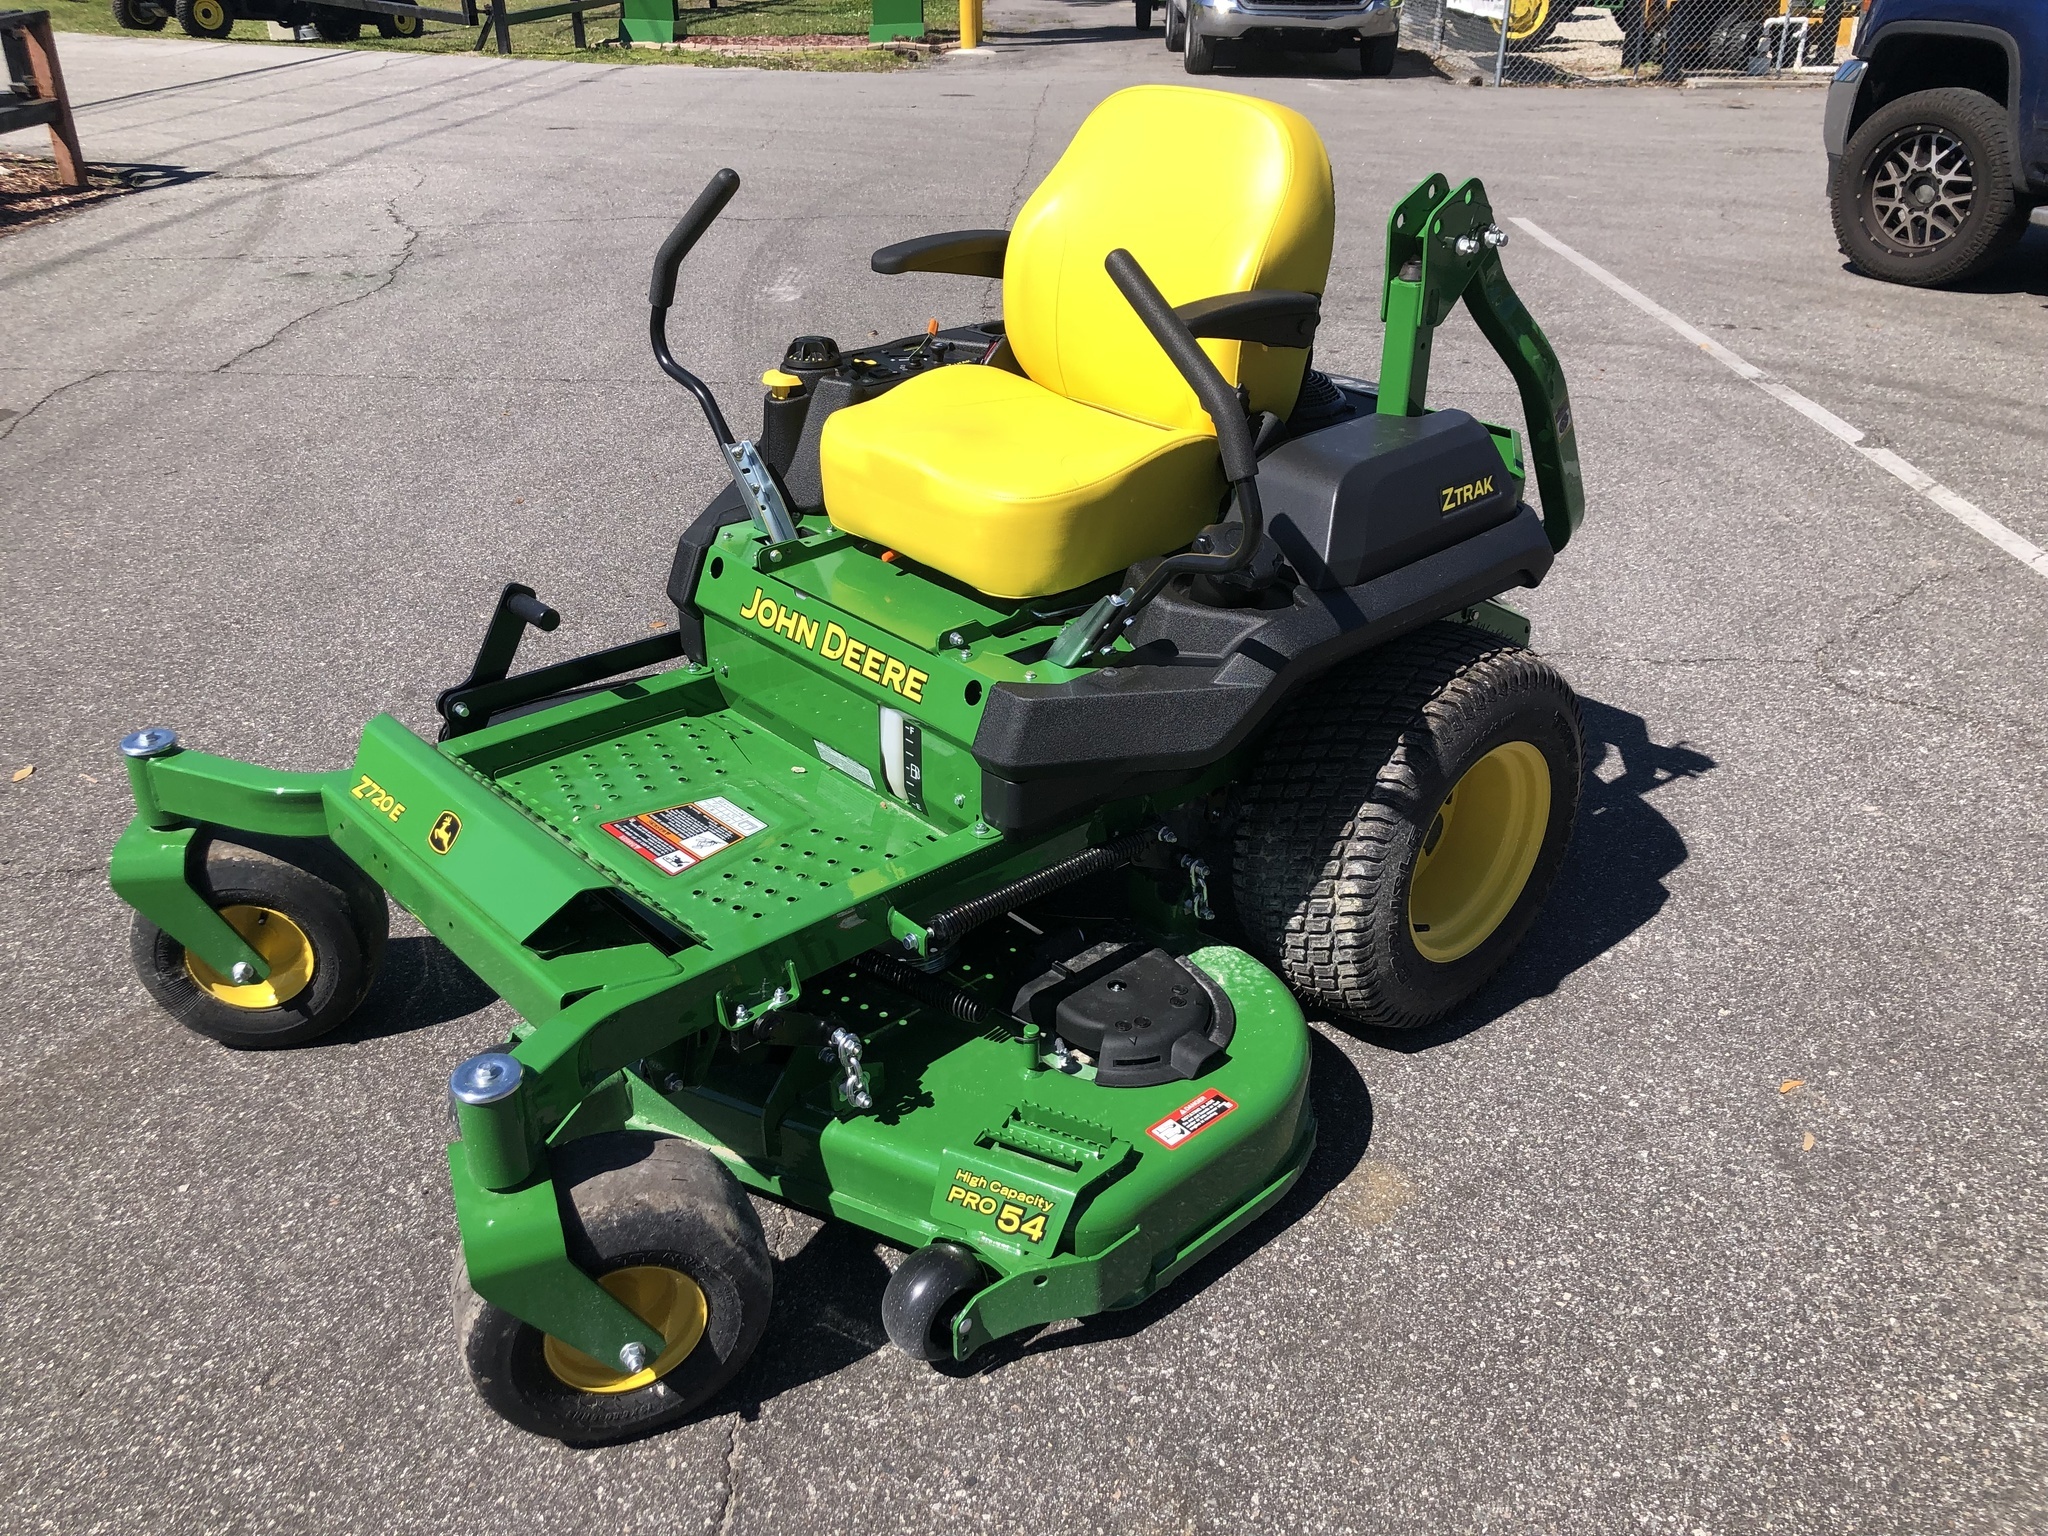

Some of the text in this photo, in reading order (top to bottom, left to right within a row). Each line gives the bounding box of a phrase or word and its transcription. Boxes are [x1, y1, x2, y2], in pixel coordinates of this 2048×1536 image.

[1442, 475, 1494, 512] ZTRAK
[740, 586, 930, 704] JOHN DEERE
[946, 1184, 1050, 1244] PRO 54
[955, 1168, 1056, 1212] High Capacity
